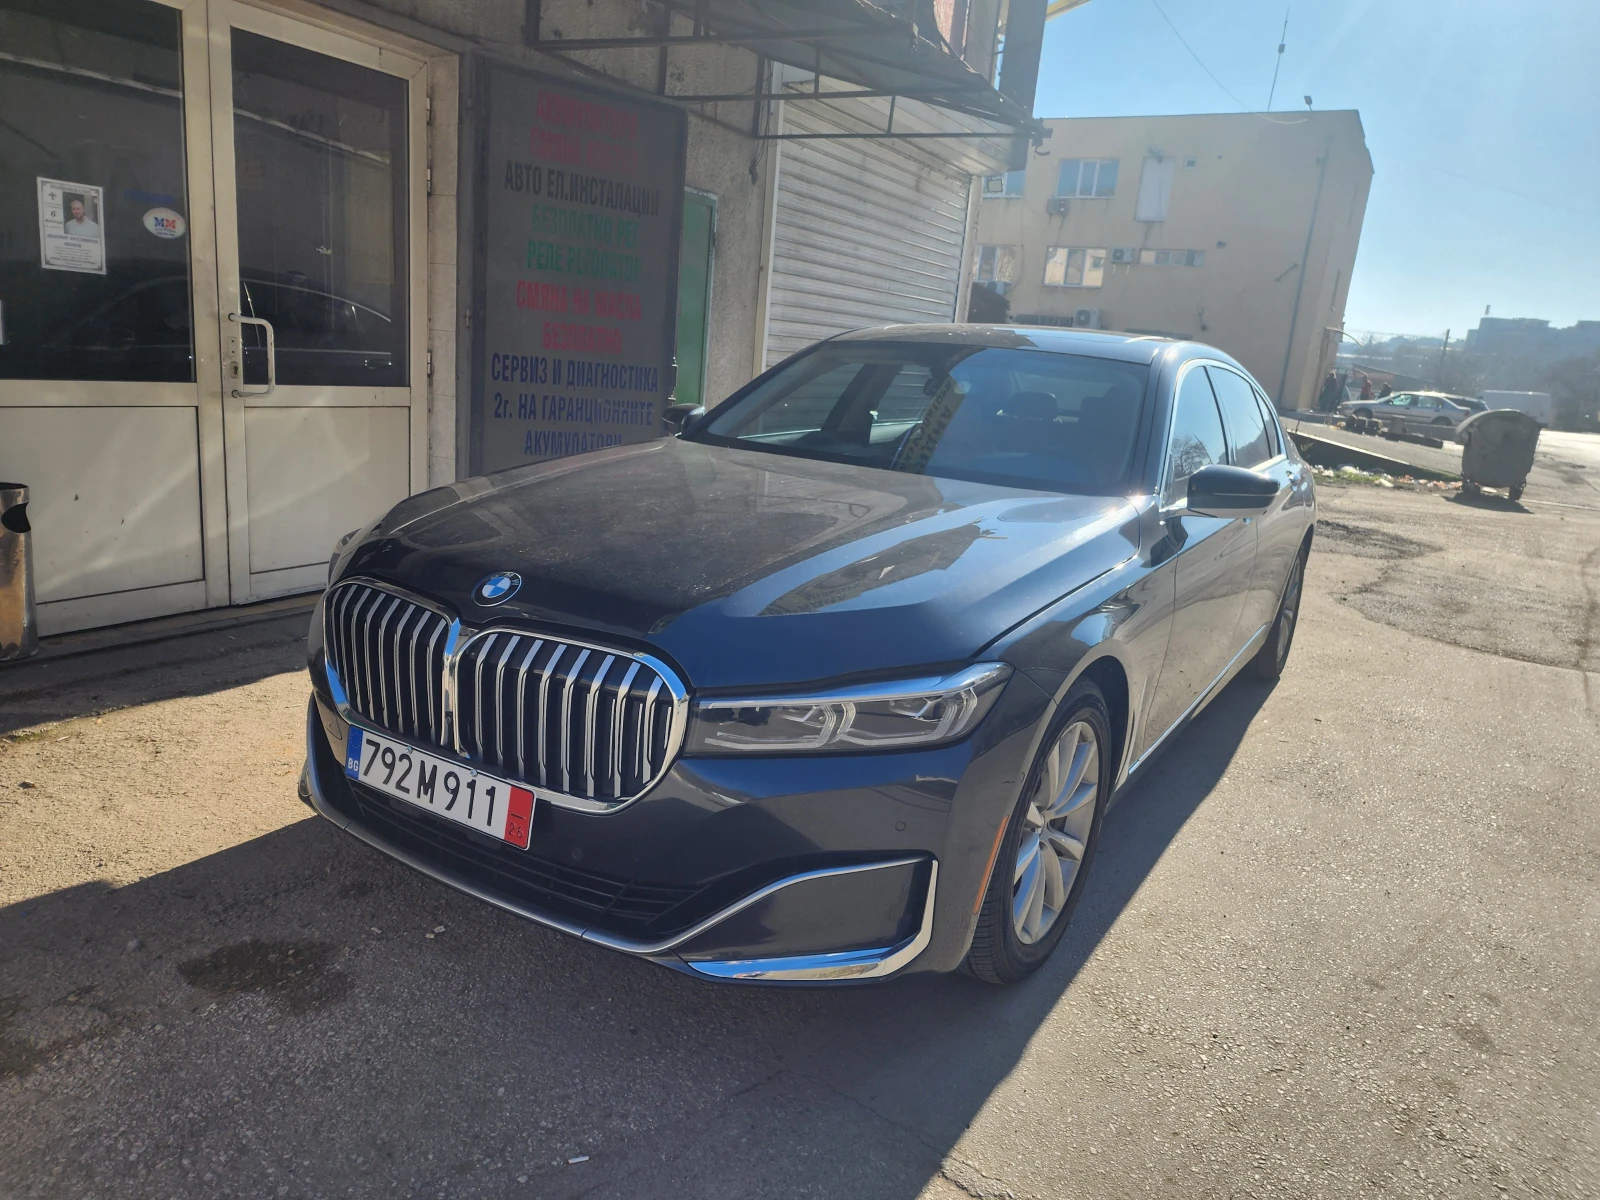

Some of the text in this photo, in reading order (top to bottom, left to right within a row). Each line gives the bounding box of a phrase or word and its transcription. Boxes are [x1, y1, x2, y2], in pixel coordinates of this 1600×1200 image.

[504, 160, 660, 217] АВТО ЕЛ.ИНСТАЛАЦИИ
[532, 203, 612, 244] БЕЗПЛАТНО
[526, 240, 562, 272] РЕЛЕ
[516, 279, 642, 321] СМЯНА НА МАСЛА
[542, 321, 622, 354] БЕЗПЛАТНО
[491, 352, 658, 392] СЕРВИЗ И ДИАГНОСТИКА
[493, 392, 654, 426] 2г. НА ГАРАНЦИОННИТЕ
[347, 738, 497, 828] BG 792M911
[508, 822, 523, 839] 26
